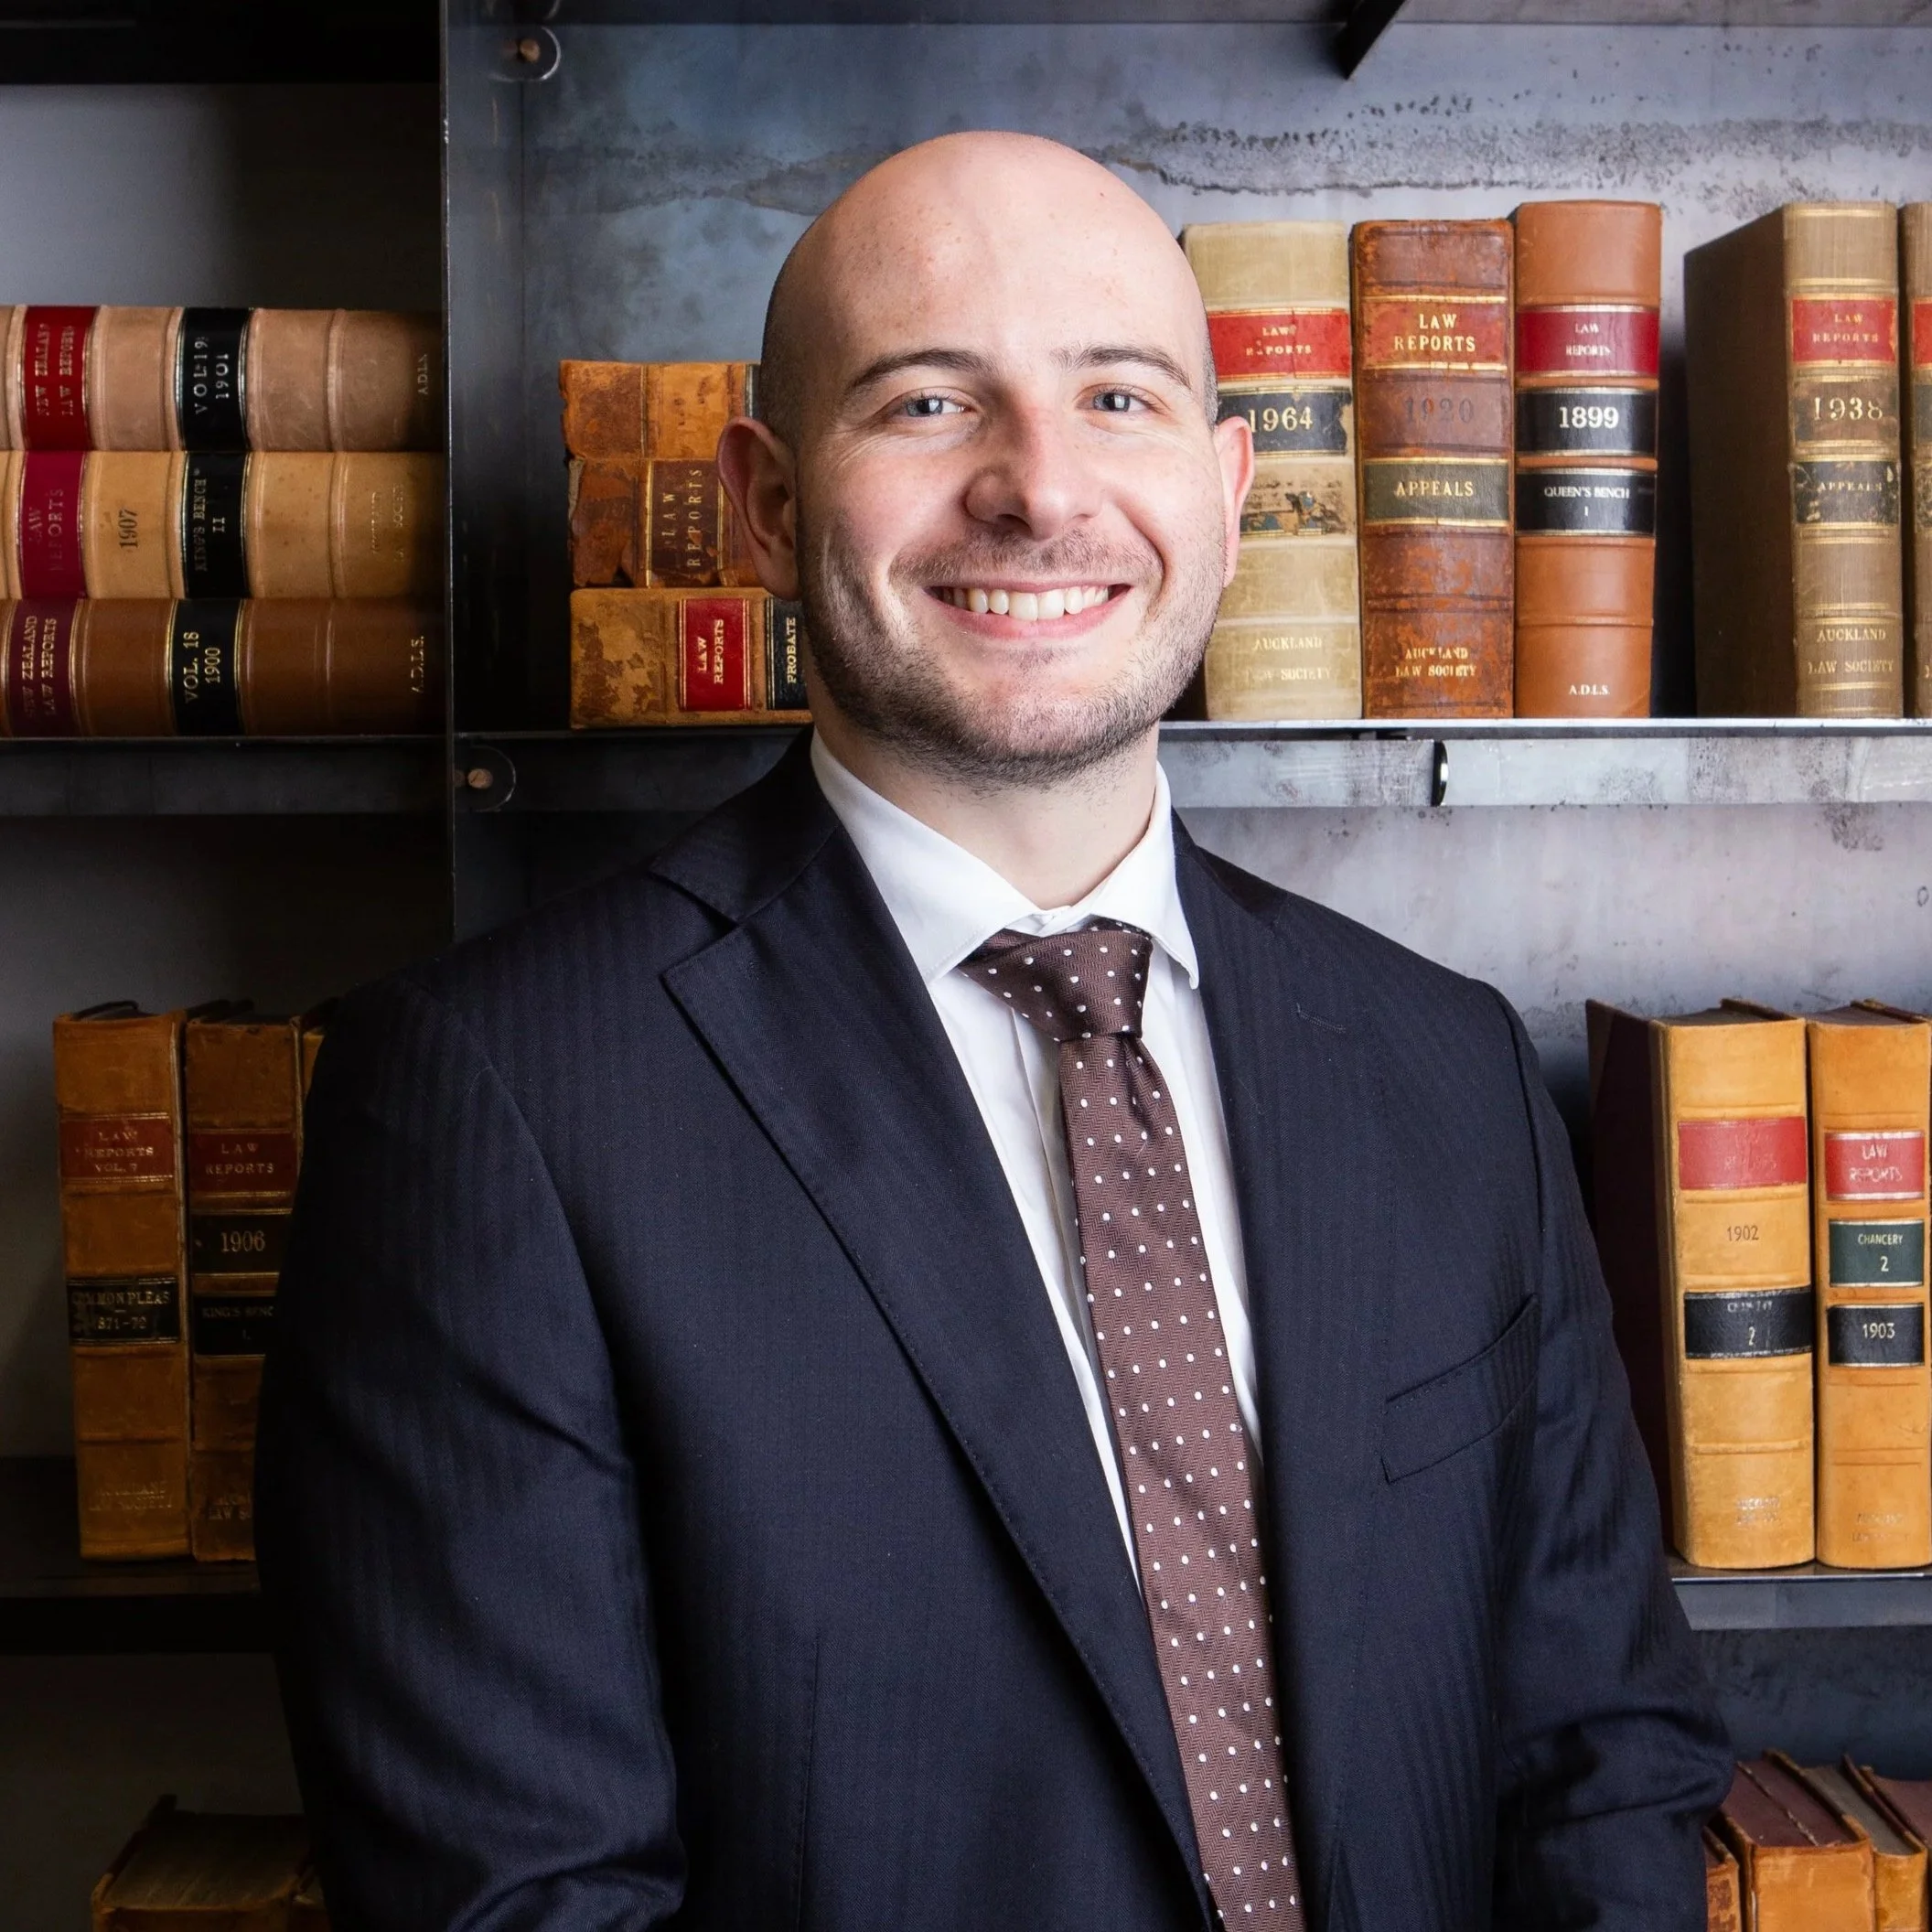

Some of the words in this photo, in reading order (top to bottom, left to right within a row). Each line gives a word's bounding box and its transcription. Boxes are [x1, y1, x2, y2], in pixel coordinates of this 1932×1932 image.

[1419, 313, 1457, 329] LAW
[1834, 313, 1864, 324] LAW
[1575, 323, 1600, 334] LAW
[1394, 335, 1476, 352] REPORTS
[1812, 332, 1880, 344] REPORTS
[1565, 344, 1612, 357] REPORTS
[215, 353, 231, 400] 1901
[1559, 406, 1619, 429] 1899
[1813, 396, 1884, 422] 1938
[1247, 406, 1314, 435] 1964
[1396, 480, 1475, 498] APPEALS
[1544, 486, 1592, 499] QUEEN'S
[1594, 487, 1629, 499] BENCH
[662, 492, 677, 536] LAW
[687, 469, 703, 567] REPORTS
[118, 509, 138, 549] 1907
[183, 631, 199, 649] 18
[1817, 628, 1886, 643] AUCKLAND
[22, 616, 38, 681] ZEALAND
[41, 617, 57, 679] REPORTS
[697, 637, 707, 673] LAW
[714, 619, 724, 685] REPORTS
[786, 617, 797, 684] PROBATE
[204, 647, 220, 684] 1900
[183, 658, 199, 703] VOL.
[221, 1143, 258, 1154] LAW
[1862, 1143, 1887, 1160] LAW
[205, 1163, 274, 1175] REPORTS
[220, 1230, 266, 1253] 1906
[1727, 1226, 1759, 1242] 1902
[1858, 1233, 1904, 1246] CHANCERY
[1880, 1256, 1890, 1272] 2
[127, 1290, 170, 1305] PLEAS
[1862, 1323, 1896, 1339] 1903
